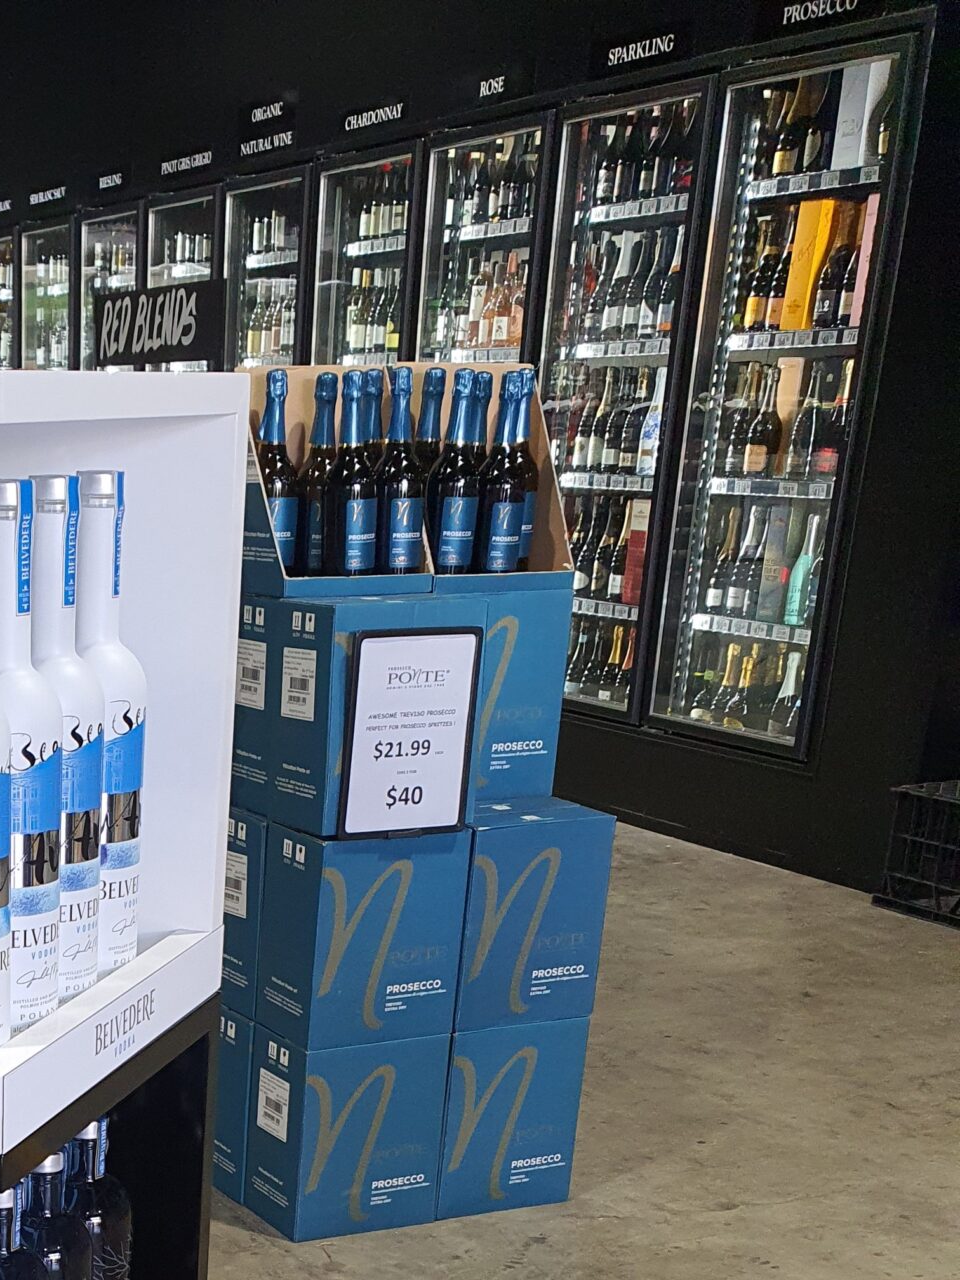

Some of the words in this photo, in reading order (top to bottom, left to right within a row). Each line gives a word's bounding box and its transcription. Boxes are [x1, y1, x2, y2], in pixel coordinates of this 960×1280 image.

[607, 34, 675, 66] SPARKLING
[480, 76, 505, 98] ROSE
[251, 102, 283, 123] ORGANIC
[345, 103, 403, 131] CHARDONNAY
[240, 135, 272, 156] NATURAL
[273, 131, 293, 150] WINE
[161, 160, 178, 175] PINOT
[100, 299, 132, 361] RED
[132, 287, 198, 355] BLENDS
[21, 512, 31, 580] BELVEDERE
[68, 509, 78, 575] BELVEDERE
[368, 711, 398, 719] AWESOME
[426, 708, 456, 716] PROSECCO
[373, 739, 431, 762] $21.99
[491, 740, 543, 752] PROSECCO
[386, 785, 423, 810] $40
[531, 964, 585, 979] PROSECCO
[386, 979, 442, 994] PROSECCO
[95, 988, 156, 1056] BELVEDERE
[114, 1033, 135, 1058] VODKA
[511, 1153, 562, 1169] PROSECCO
[371, 1174, 425, 1190] PROSECCO
